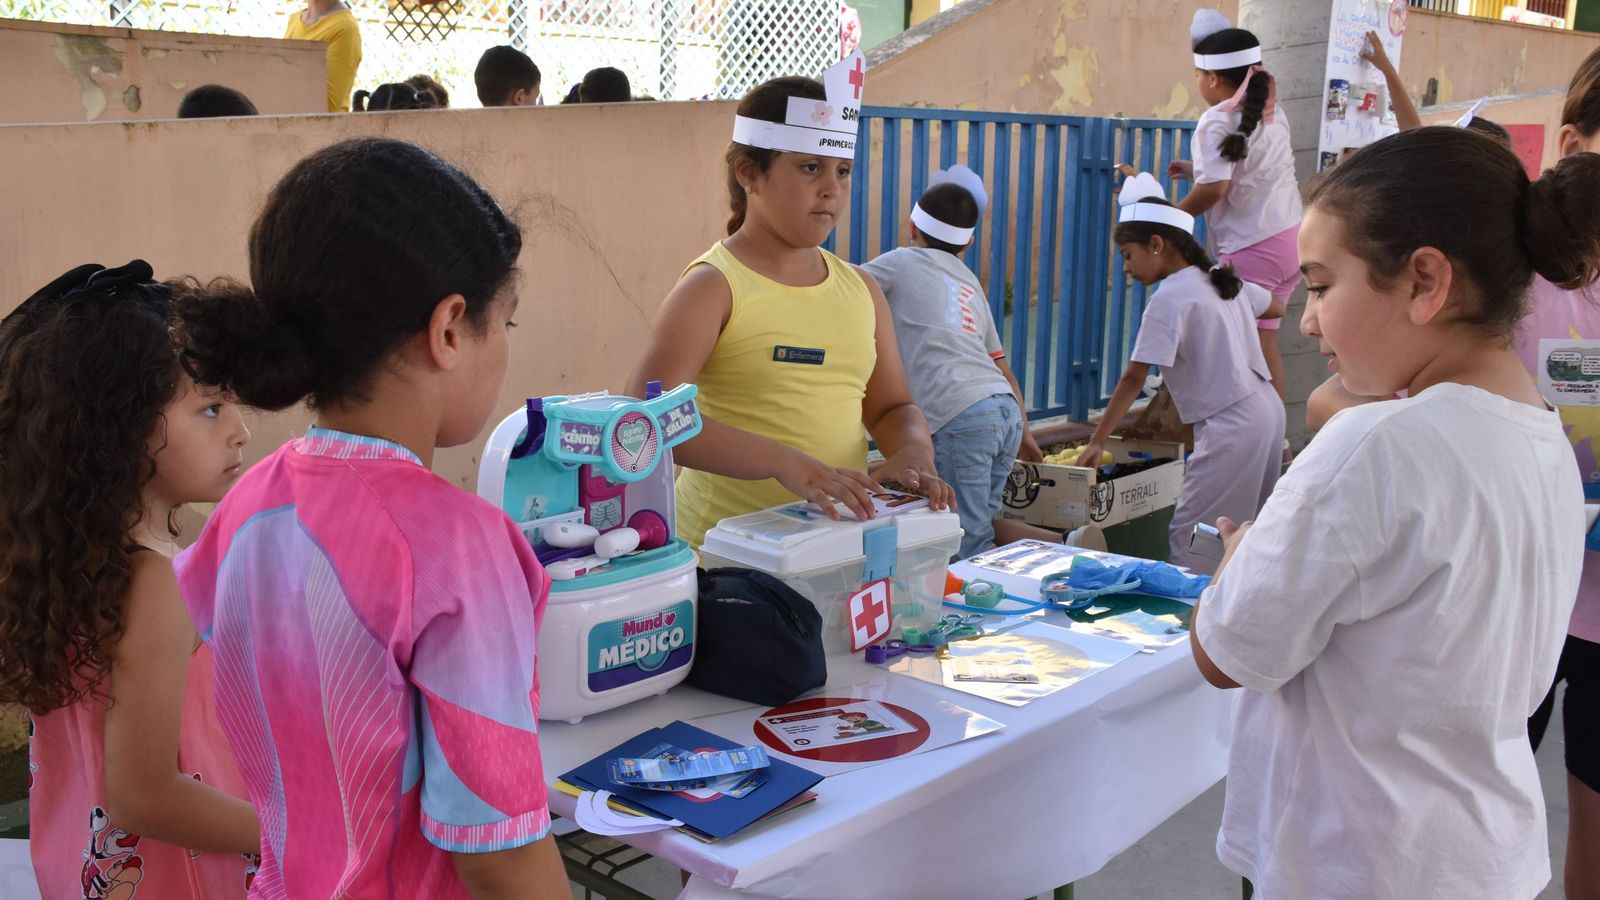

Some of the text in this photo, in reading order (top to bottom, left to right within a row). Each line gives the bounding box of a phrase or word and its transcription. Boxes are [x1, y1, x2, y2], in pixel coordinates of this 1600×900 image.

[819, 137, 854, 150] ¡PRIMEROS
[789, 350, 823, 361] Enfermera
[667, 406, 682, 421] DE
[665, 415, 692, 437] SALUD
[564, 431, 600, 445] CENTRO
[1120, 482, 1159, 505] TERRALL
[598, 627, 685, 669] MÉDICO
